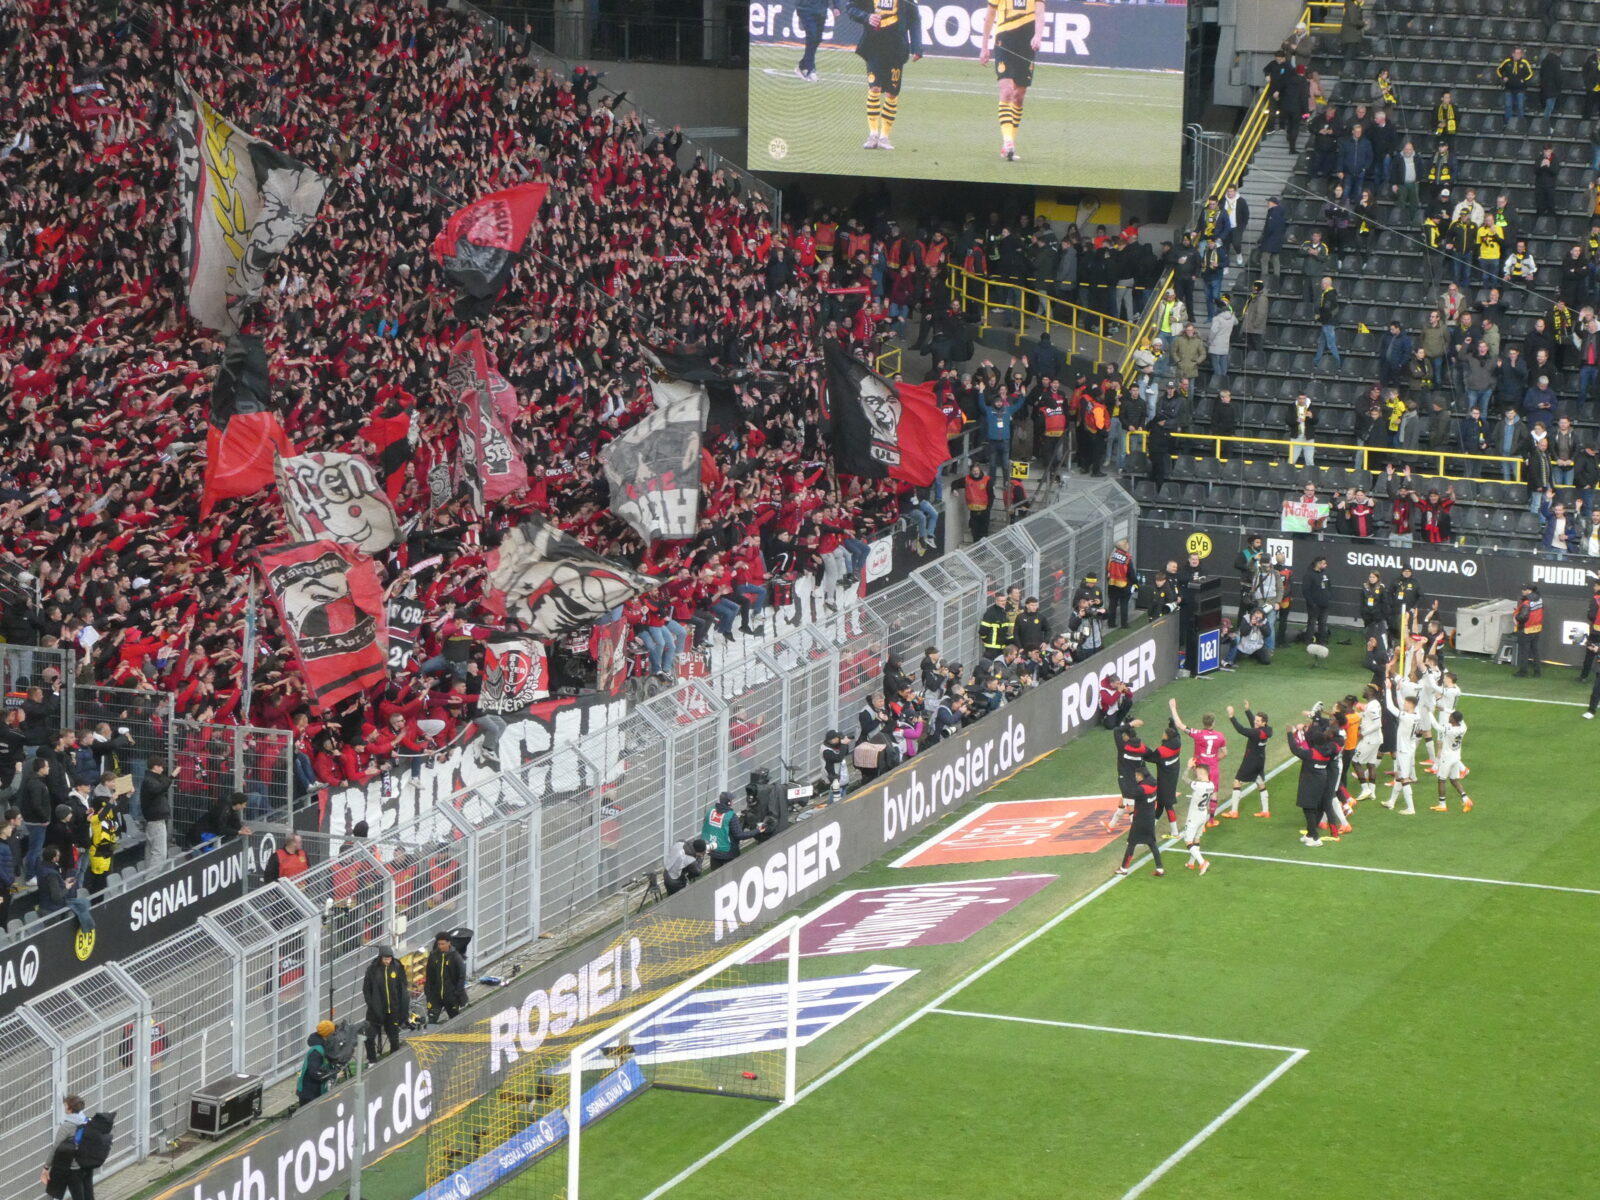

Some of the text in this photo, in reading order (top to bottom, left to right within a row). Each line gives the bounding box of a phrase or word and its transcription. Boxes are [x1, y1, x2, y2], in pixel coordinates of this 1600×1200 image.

[749, 2, 835, 40] er.e
[907, 5, 1091, 56] ROSER
[1190, 535, 1209, 552] BVB
[1270, 544, 1291, 560] 1&1
[1347, 551, 1459, 575] SIGNAL IDUNA
[1532, 564, 1586, 587] PUMA
[1200, 638, 1217, 662] 1&1
[883, 714, 1026, 843] bvb.rosier.de
[130, 846, 257, 932] SIGNAL IDUNA
[713, 820, 842, 942] ROSIER
[490, 936, 642, 1075] ROSIER
[585, 1094, 608, 1118] SIGNAL
[193, 1060, 433, 1200] brosir.de
